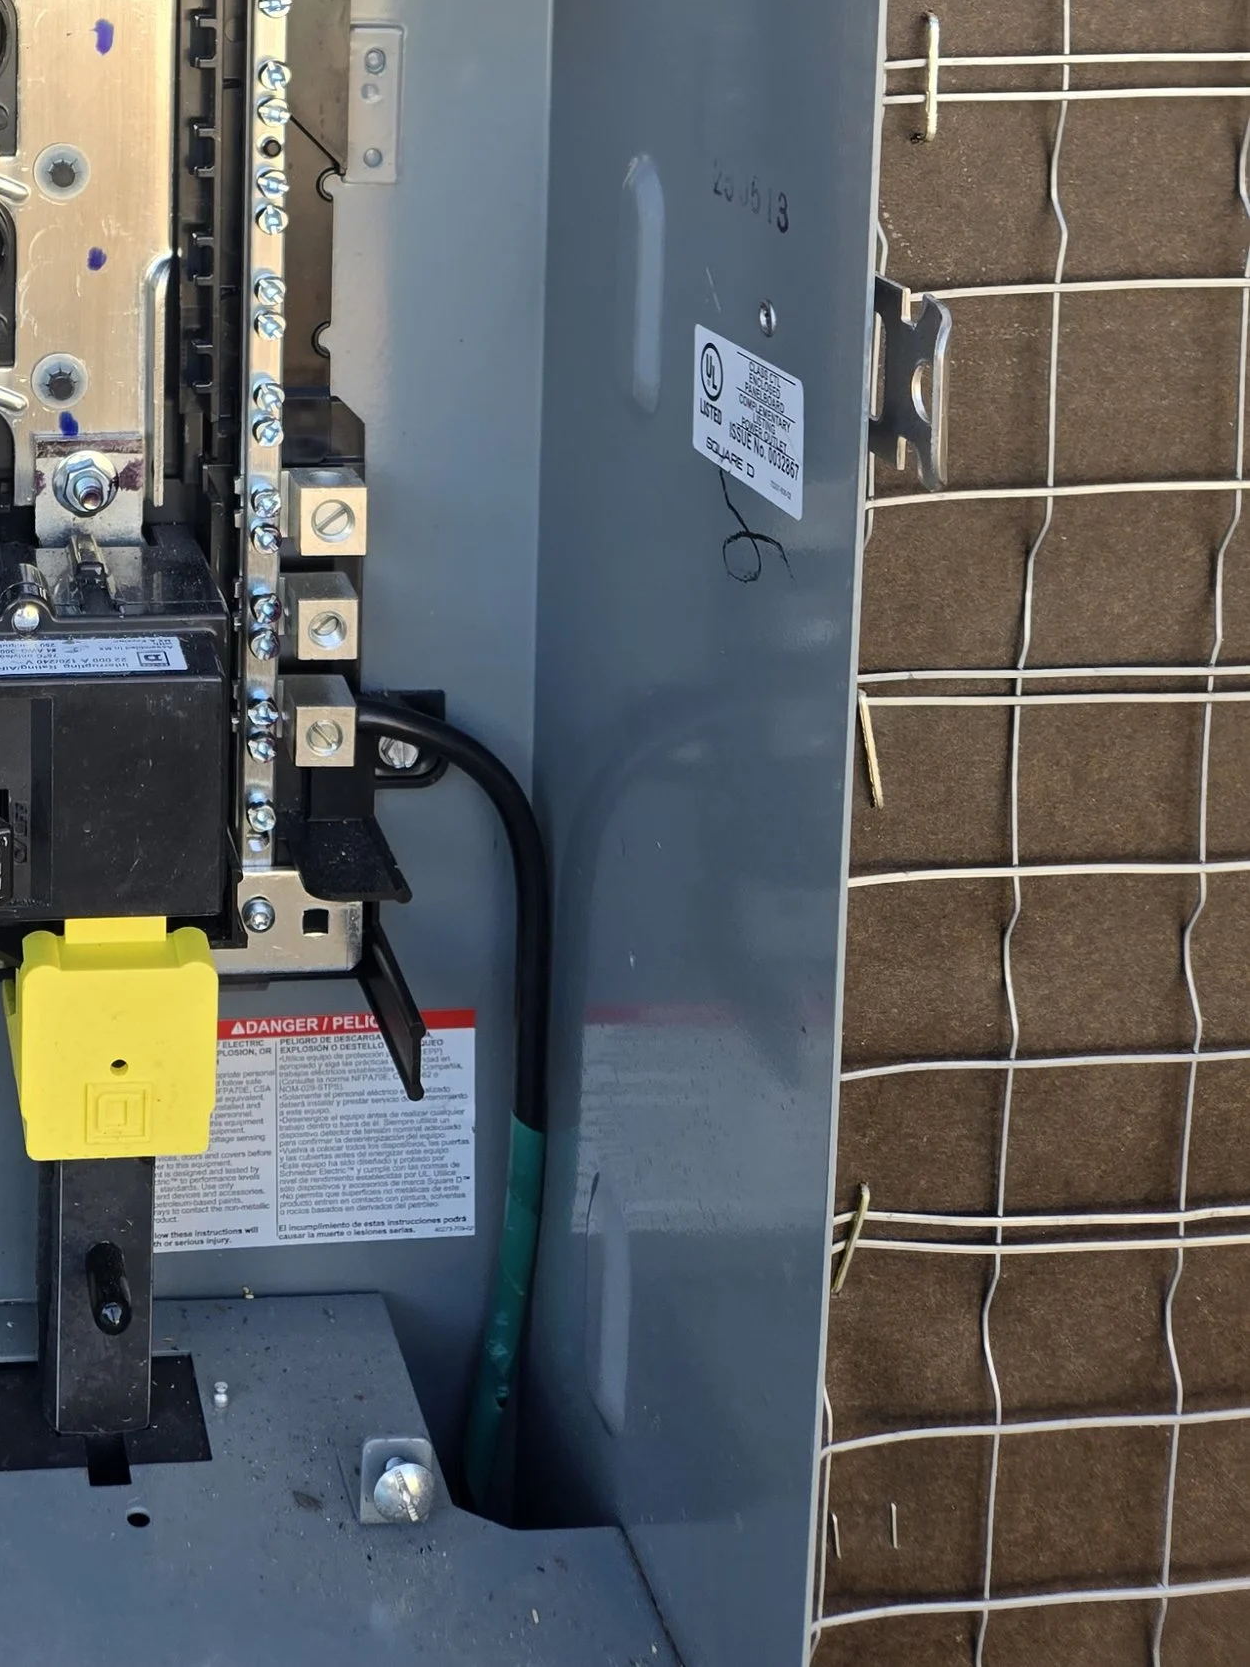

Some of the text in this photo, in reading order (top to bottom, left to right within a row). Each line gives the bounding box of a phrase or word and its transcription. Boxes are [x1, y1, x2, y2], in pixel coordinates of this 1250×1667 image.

[744, 382, 785, 414] PANELBOARD
[749, 372, 781, 400] ENCLOSED
[700, 397, 722, 426] LISTED
[739, 394, 791, 434] COMPLEMENTARY
[753, 413, 776, 435] LISTING
[729, 421, 751, 451] ISSUE
[706, 436, 744, 472] SQUARE
[246, 1018, 318, 1034] DANGER
[340, 1042, 384, 1050] DESTELLO
[195, 1228, 242, 1237] instructions
